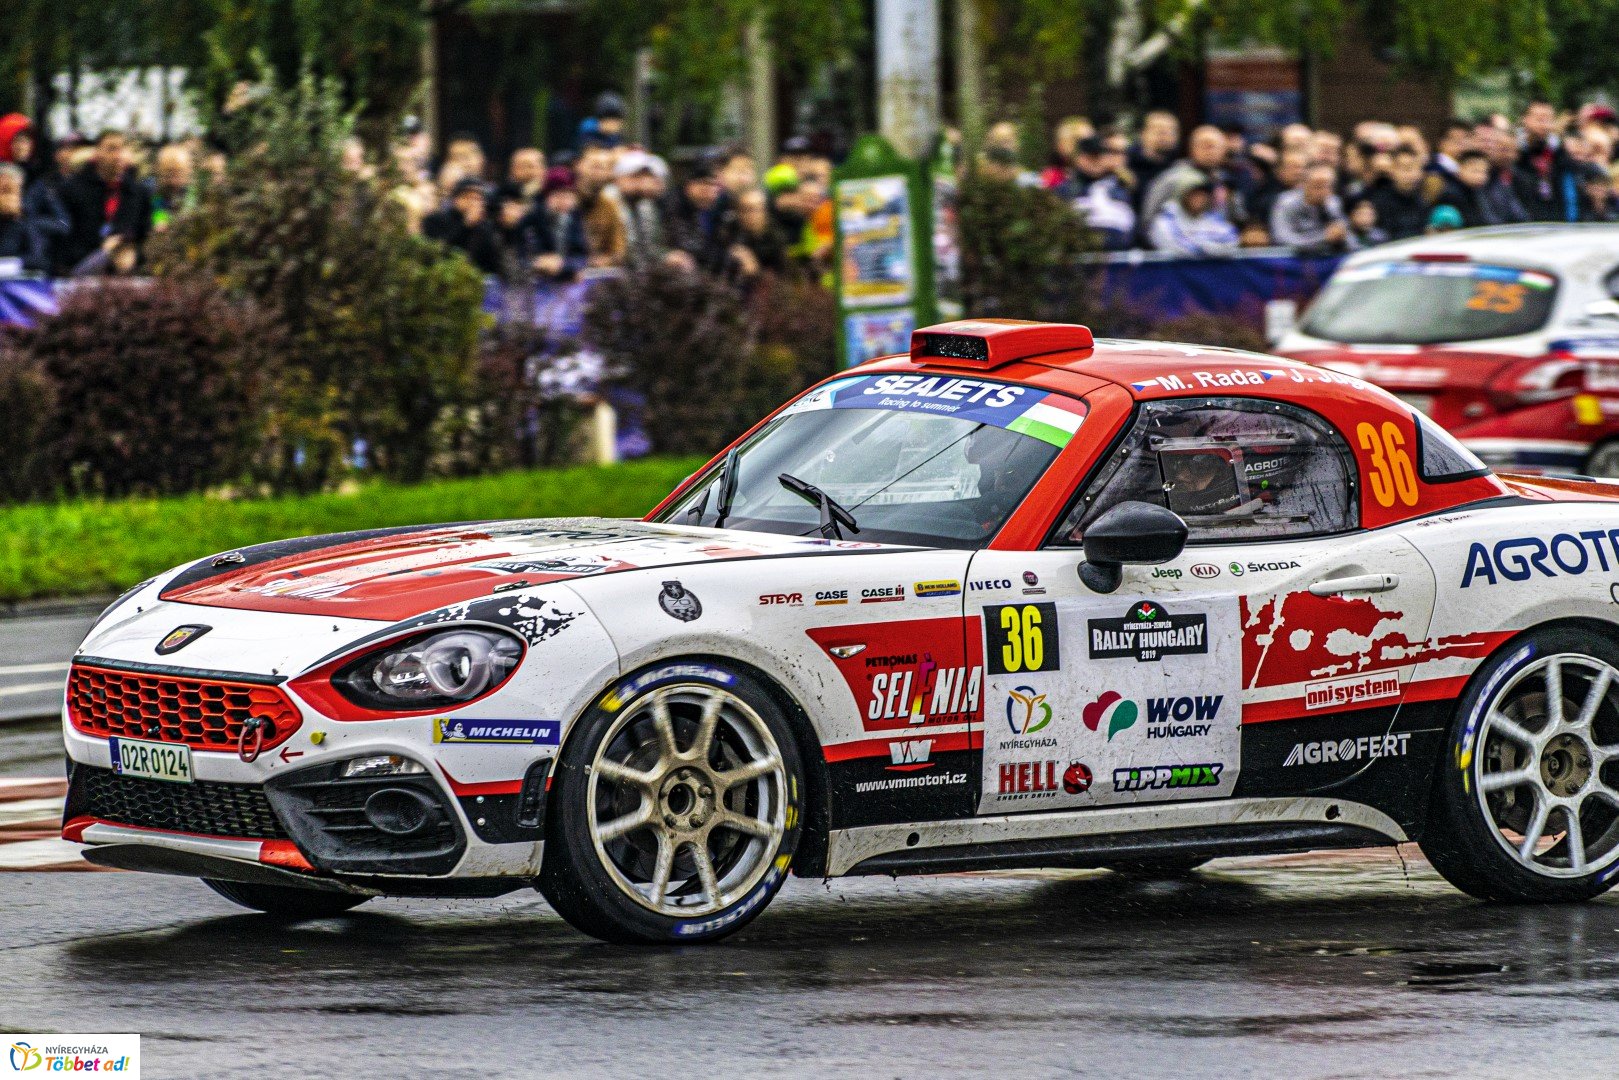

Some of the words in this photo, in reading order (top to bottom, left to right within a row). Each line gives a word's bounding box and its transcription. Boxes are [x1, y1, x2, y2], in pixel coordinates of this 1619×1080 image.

[1155, 374, 1193, 391] M.
[1192, 369, 1264, 388] Rada
[1290, 368, 1313, 383] J.
[864, 375, 1025, 408] SEAJETS
[878, 397, 910, 408] Racing
[921, 402, 960, 412] summer
[1357, 421, 1419, 508] 36
[1151, 567, 1183, 579] Jeep
[1195, 566, 1216, 576] KIA
[1248, 560, 1302, 572] ŠKODA
[861, 587, 892, 597] CASE
[969, 580, 1012, 591] IVECO
[759, 592, 803, 605] STEYR
[815, 590, 848, 600] CASE
[1001, 605, 1044, 672] 36
[1092, 628, 1136, 651] RALLY
[1139, 623, 1205, 649] HUNGARY
[865, 654, 917, 668] PETRONAS
[1141, 650, 1157, 660] 2019
[868, 654, 983, 724] SELENIA
[1307, 679, 1399, 706] onisystem
[1147, 694, 1224, 723] WOW
[928, 714, 960, 724] MOTOR
[468, 727, 551, 738] MICHELIN
[1147, 724, 1211, 739] HUNGARY
[1000, 737, 1057, 750] NYÍREGYHÁZA
[1282, 733, 1412, 767] AGROFERT
[856, 771, 967, 793] www.vmmotori.cz
[998, 760, 1059, 794] HELL
